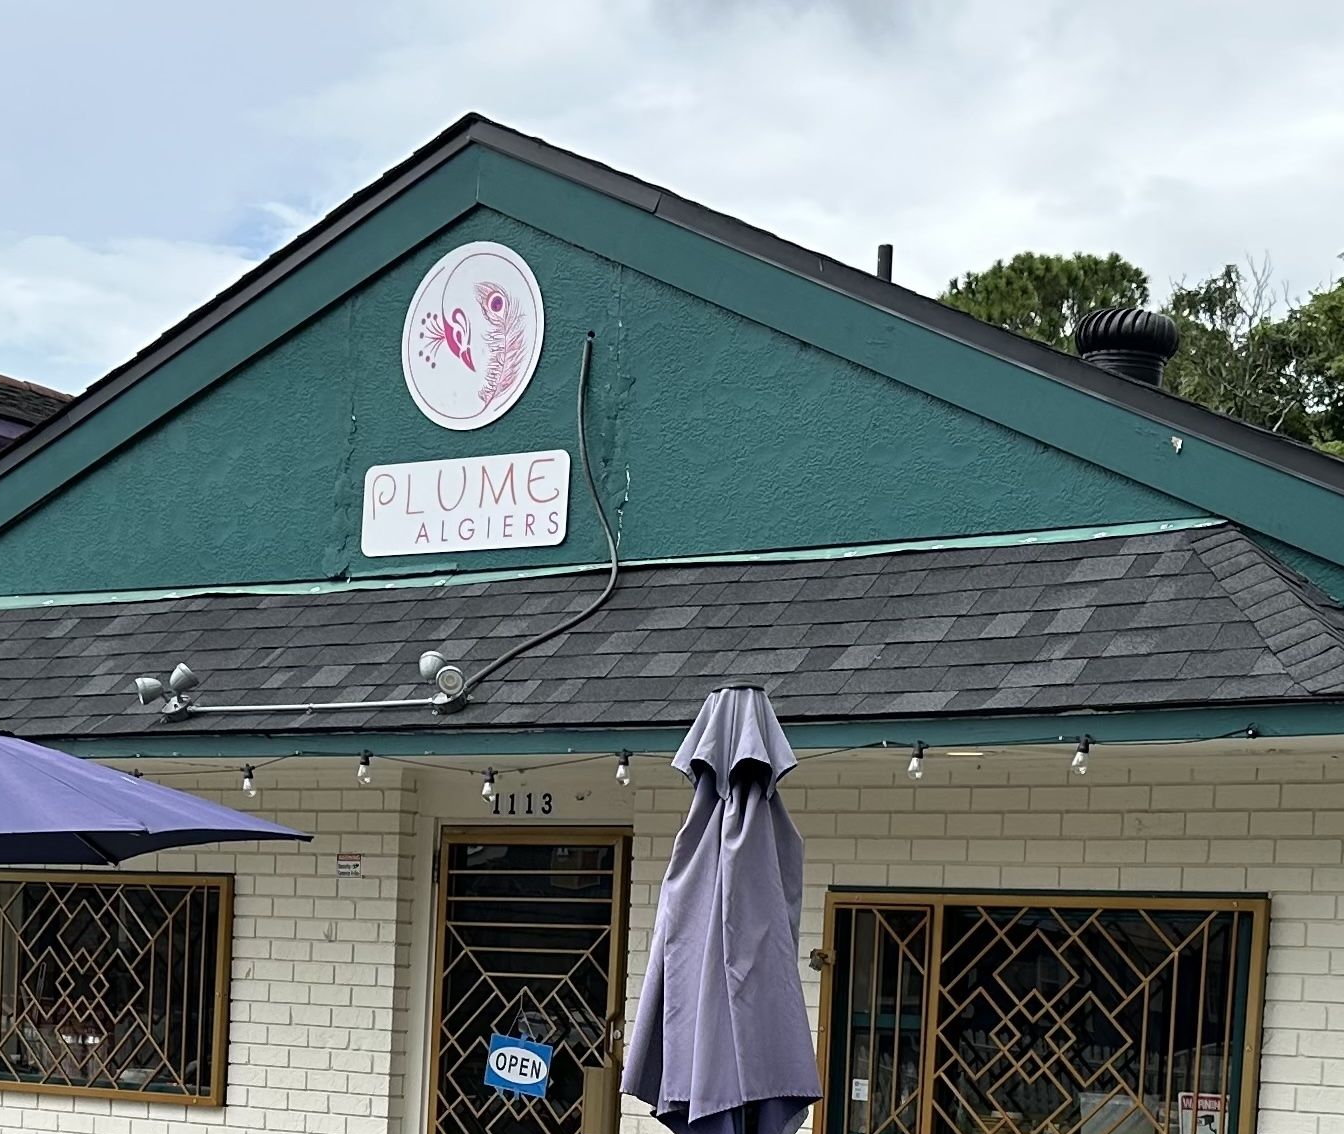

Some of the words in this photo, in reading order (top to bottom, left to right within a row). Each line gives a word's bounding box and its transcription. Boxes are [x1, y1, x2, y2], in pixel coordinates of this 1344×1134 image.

[372, 457, 560, 521] PLUME
[414, 511, 559, 544] ALGIERS
[492, 792, 553, 815] 1113
[495, 1051, 543, 1080] OPEN
